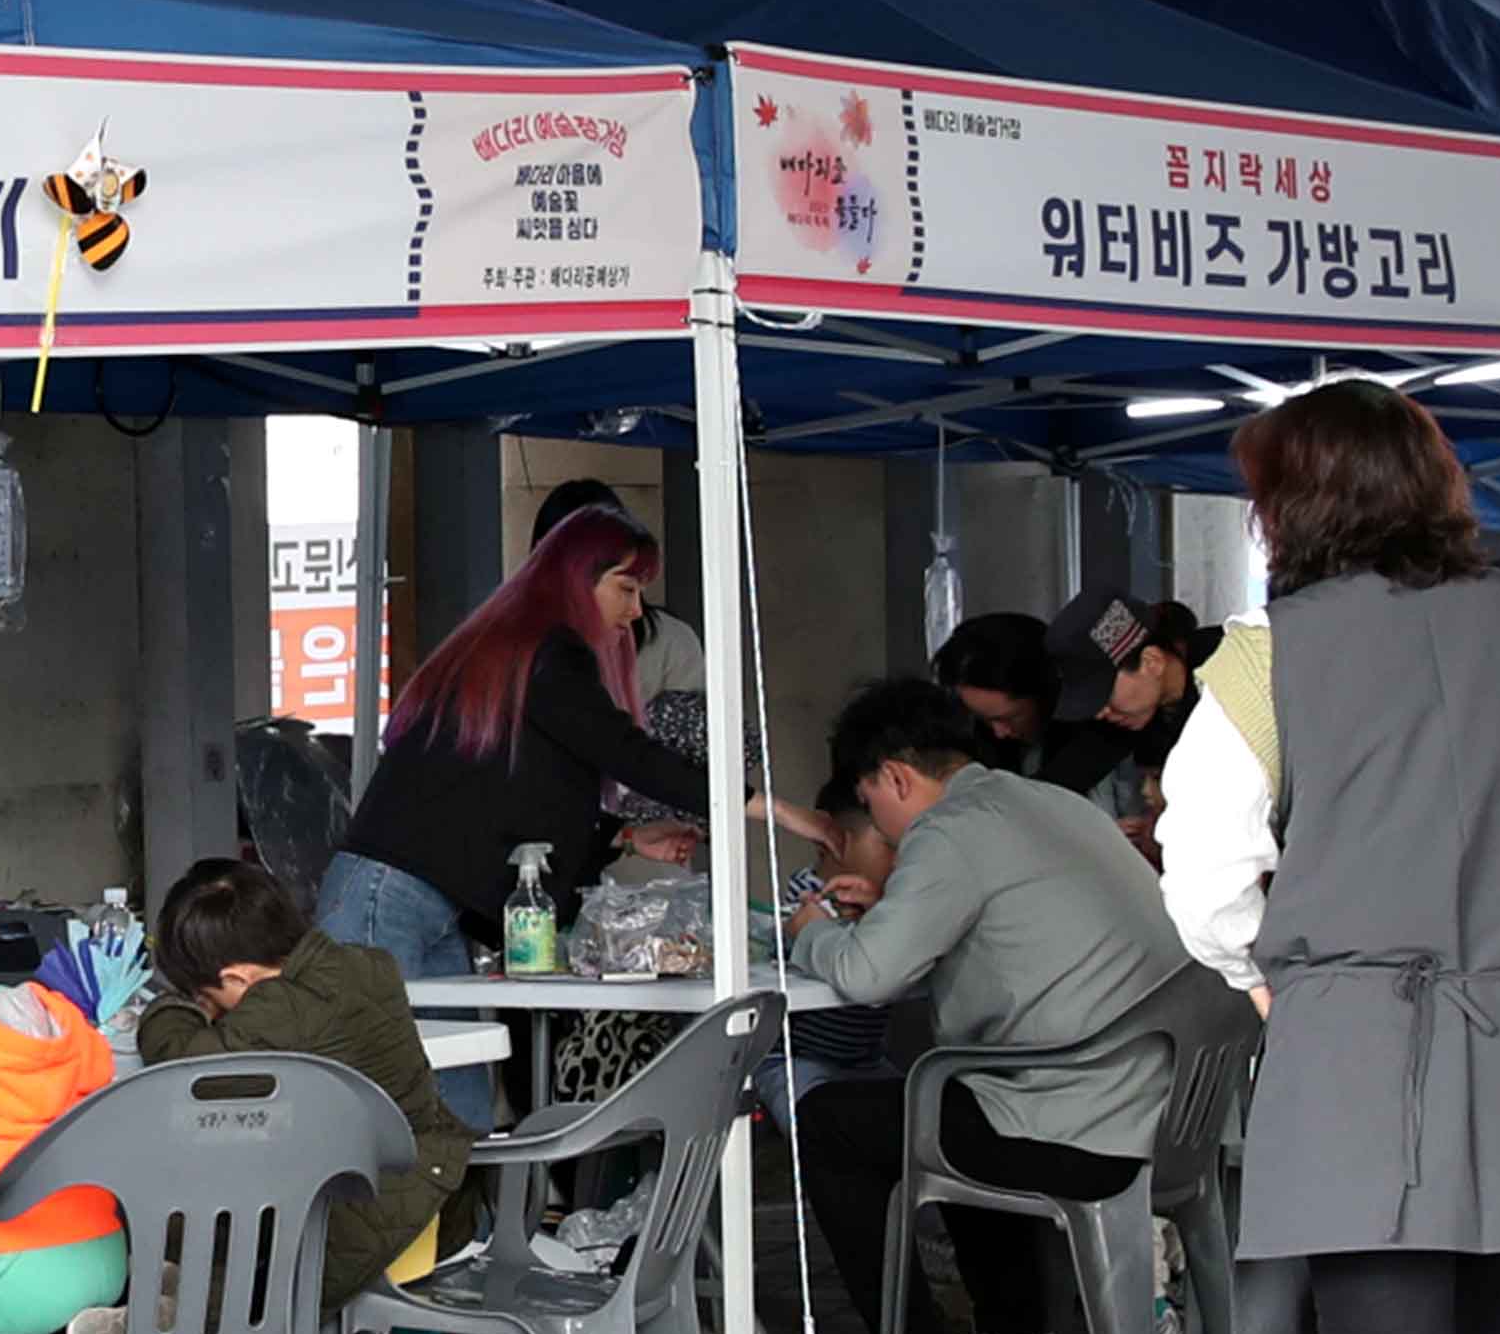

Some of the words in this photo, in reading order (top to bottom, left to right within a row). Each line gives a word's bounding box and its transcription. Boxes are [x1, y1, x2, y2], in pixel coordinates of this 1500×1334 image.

[472, 119, 534, 163] 배다리
[1041, 197, 1246, 289] 워터비즈
[1267, 219, 1457, 304] 가방고리
